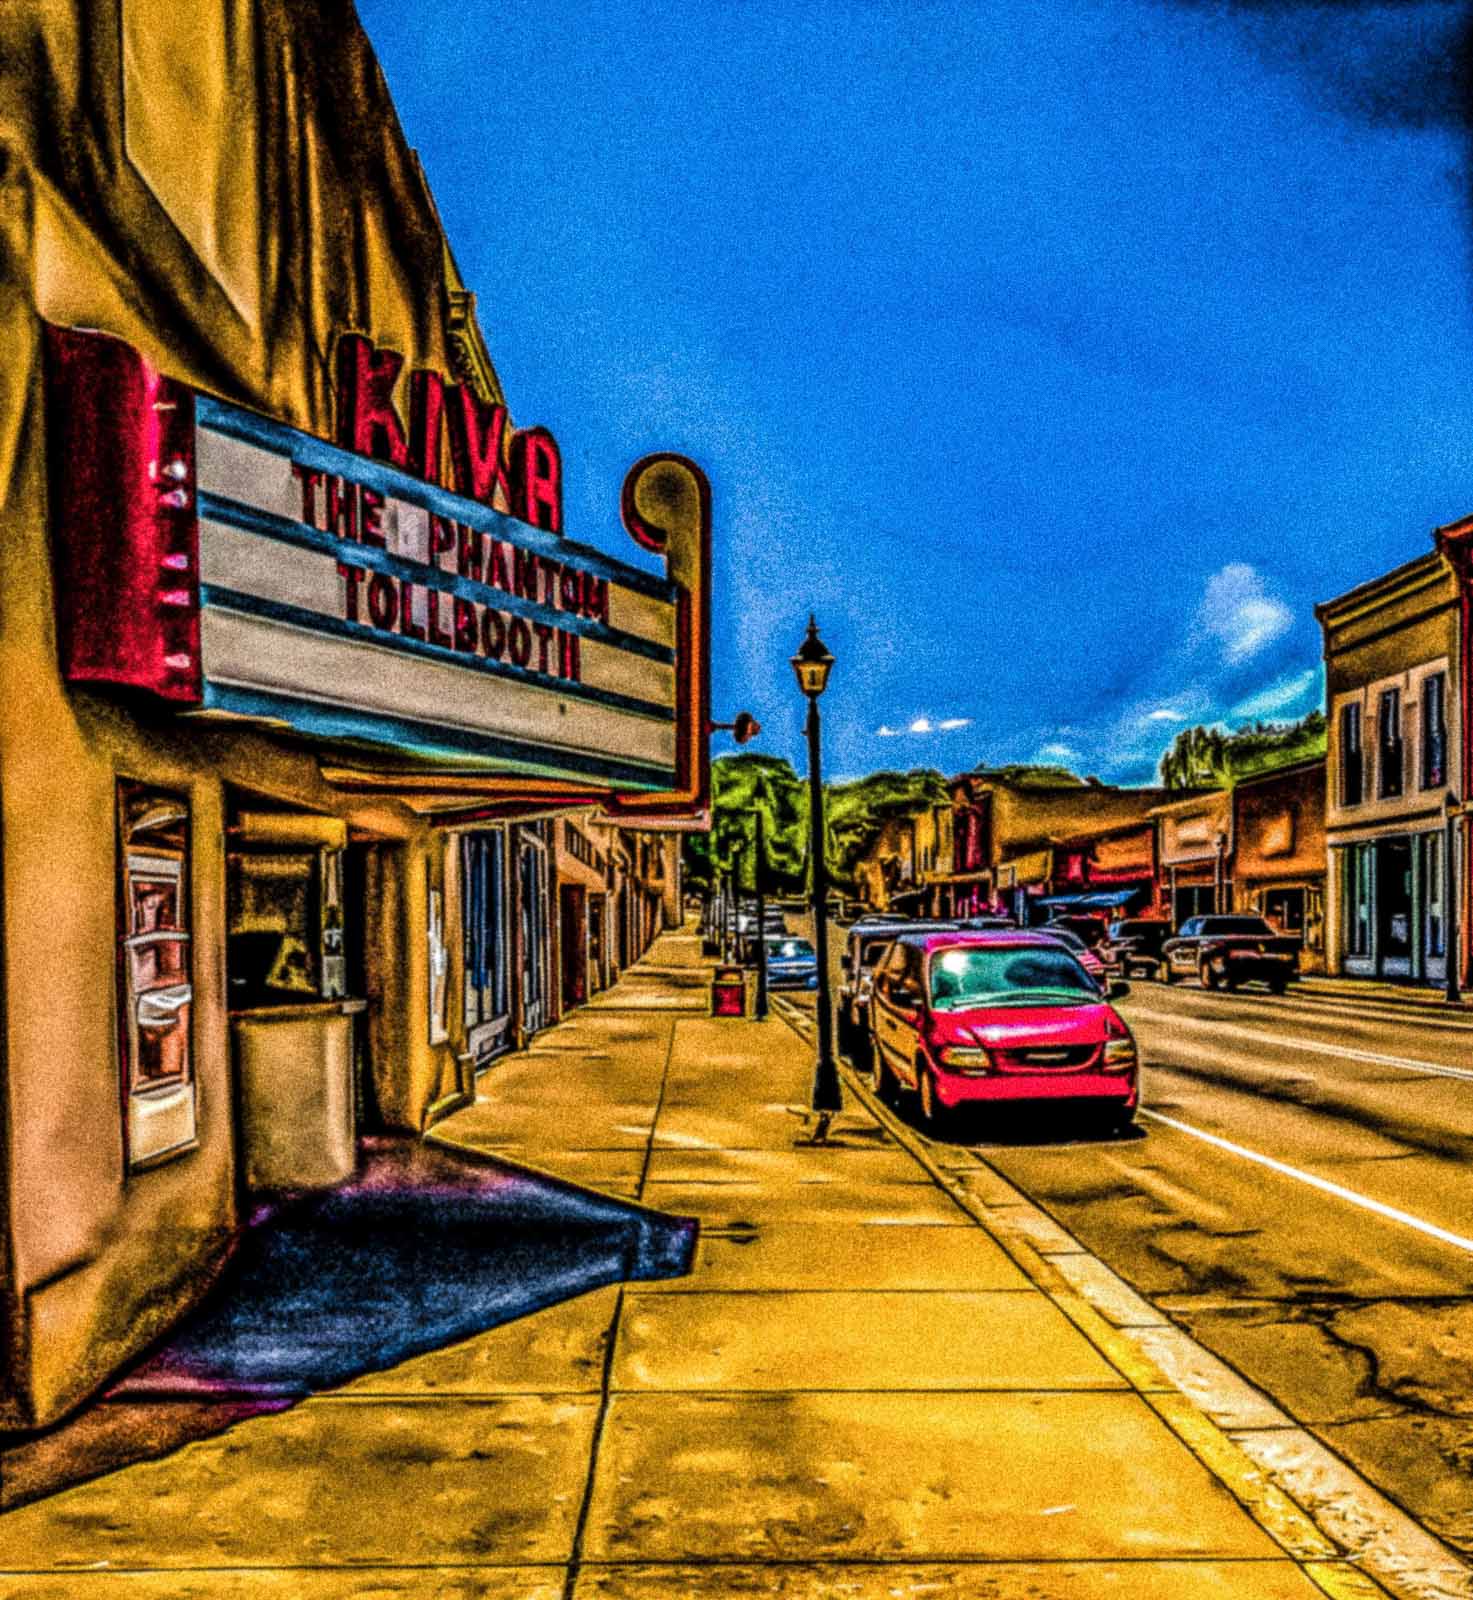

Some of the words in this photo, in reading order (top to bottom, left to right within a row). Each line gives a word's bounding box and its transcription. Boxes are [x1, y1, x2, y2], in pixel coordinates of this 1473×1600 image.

[337, 335, 562, 532] KIVA
[293, 463, 387, 547] THE
[429, 515, 609, 625] PHANTOM
[337, 563, 580, 681] TOLLBOOTH
